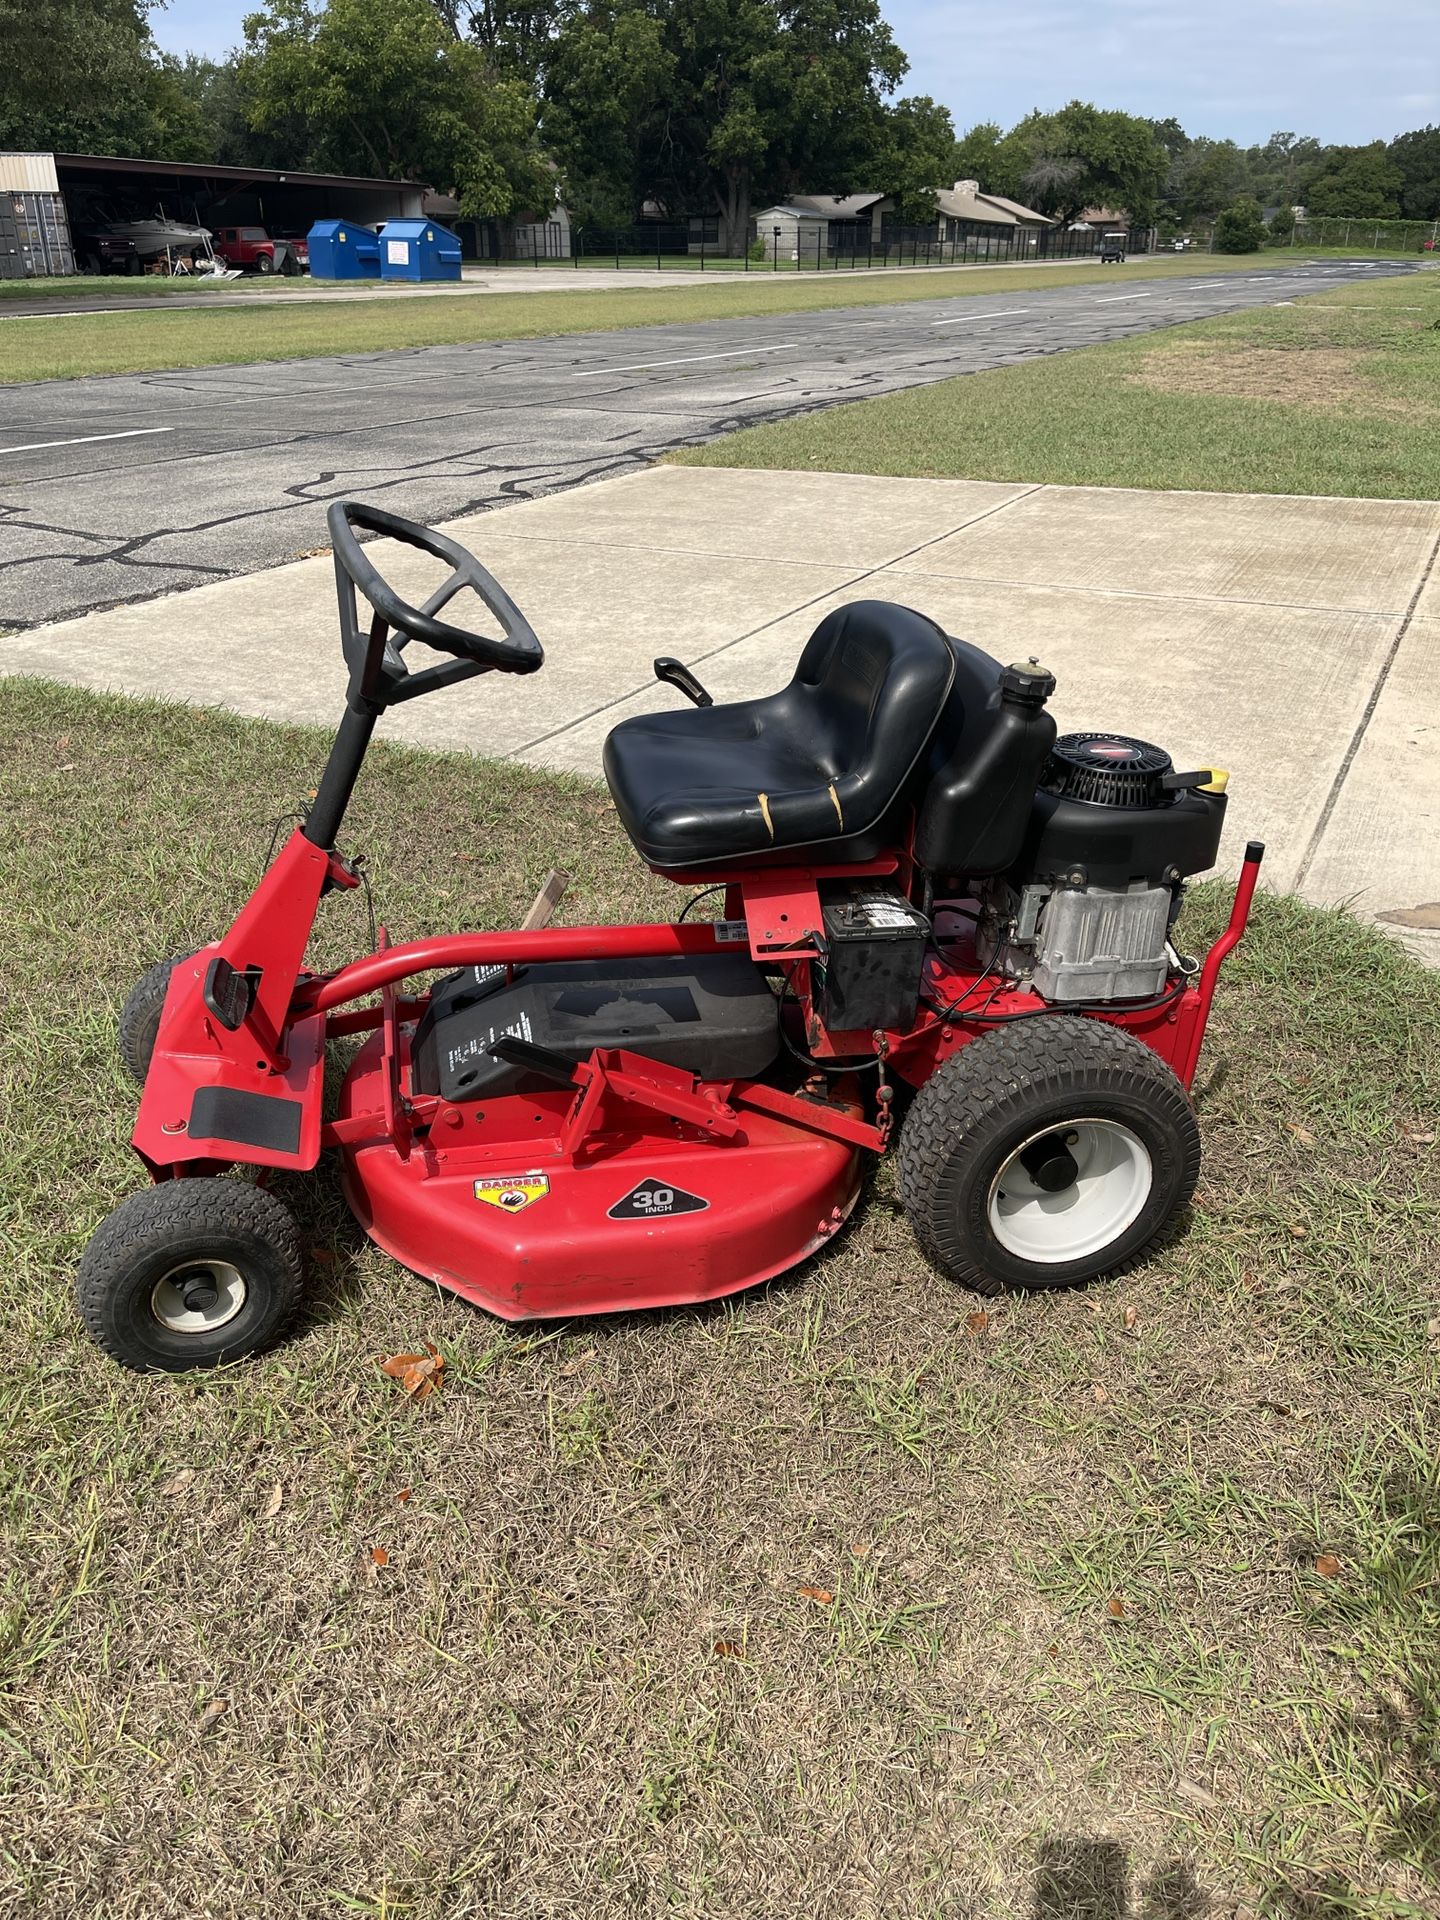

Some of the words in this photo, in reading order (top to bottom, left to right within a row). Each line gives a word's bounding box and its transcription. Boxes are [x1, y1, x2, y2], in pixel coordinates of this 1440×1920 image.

[481, 1177, 542, 1189] DANGER
[632, 1188, 674, 1208] 30
[645, 1204, 673, 1214] INCH
